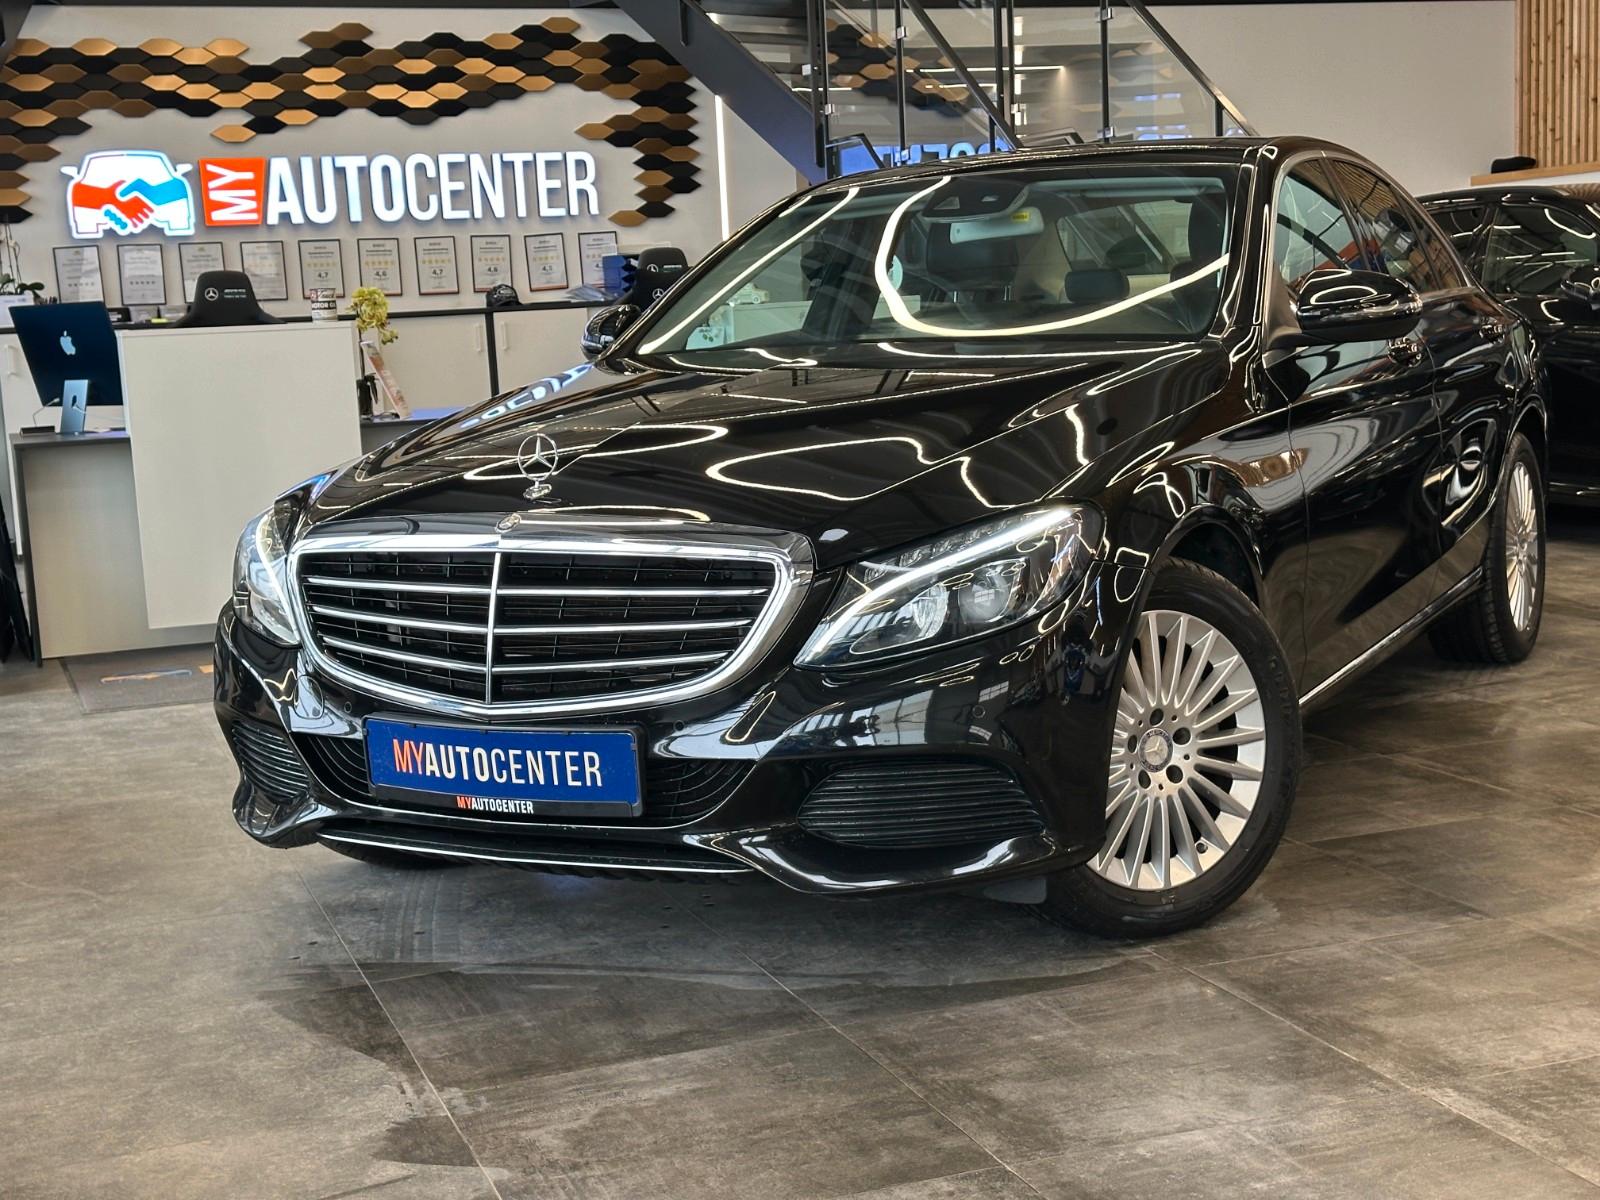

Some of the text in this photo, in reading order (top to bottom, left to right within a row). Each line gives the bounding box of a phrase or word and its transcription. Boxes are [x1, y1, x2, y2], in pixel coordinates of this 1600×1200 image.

[206, 151, 599, 225] MY AUTOCENTER
[392, 738, 603, 787] MYAUTOCENTER
[456, 796, 534, 814] MYAUTOCENTER
